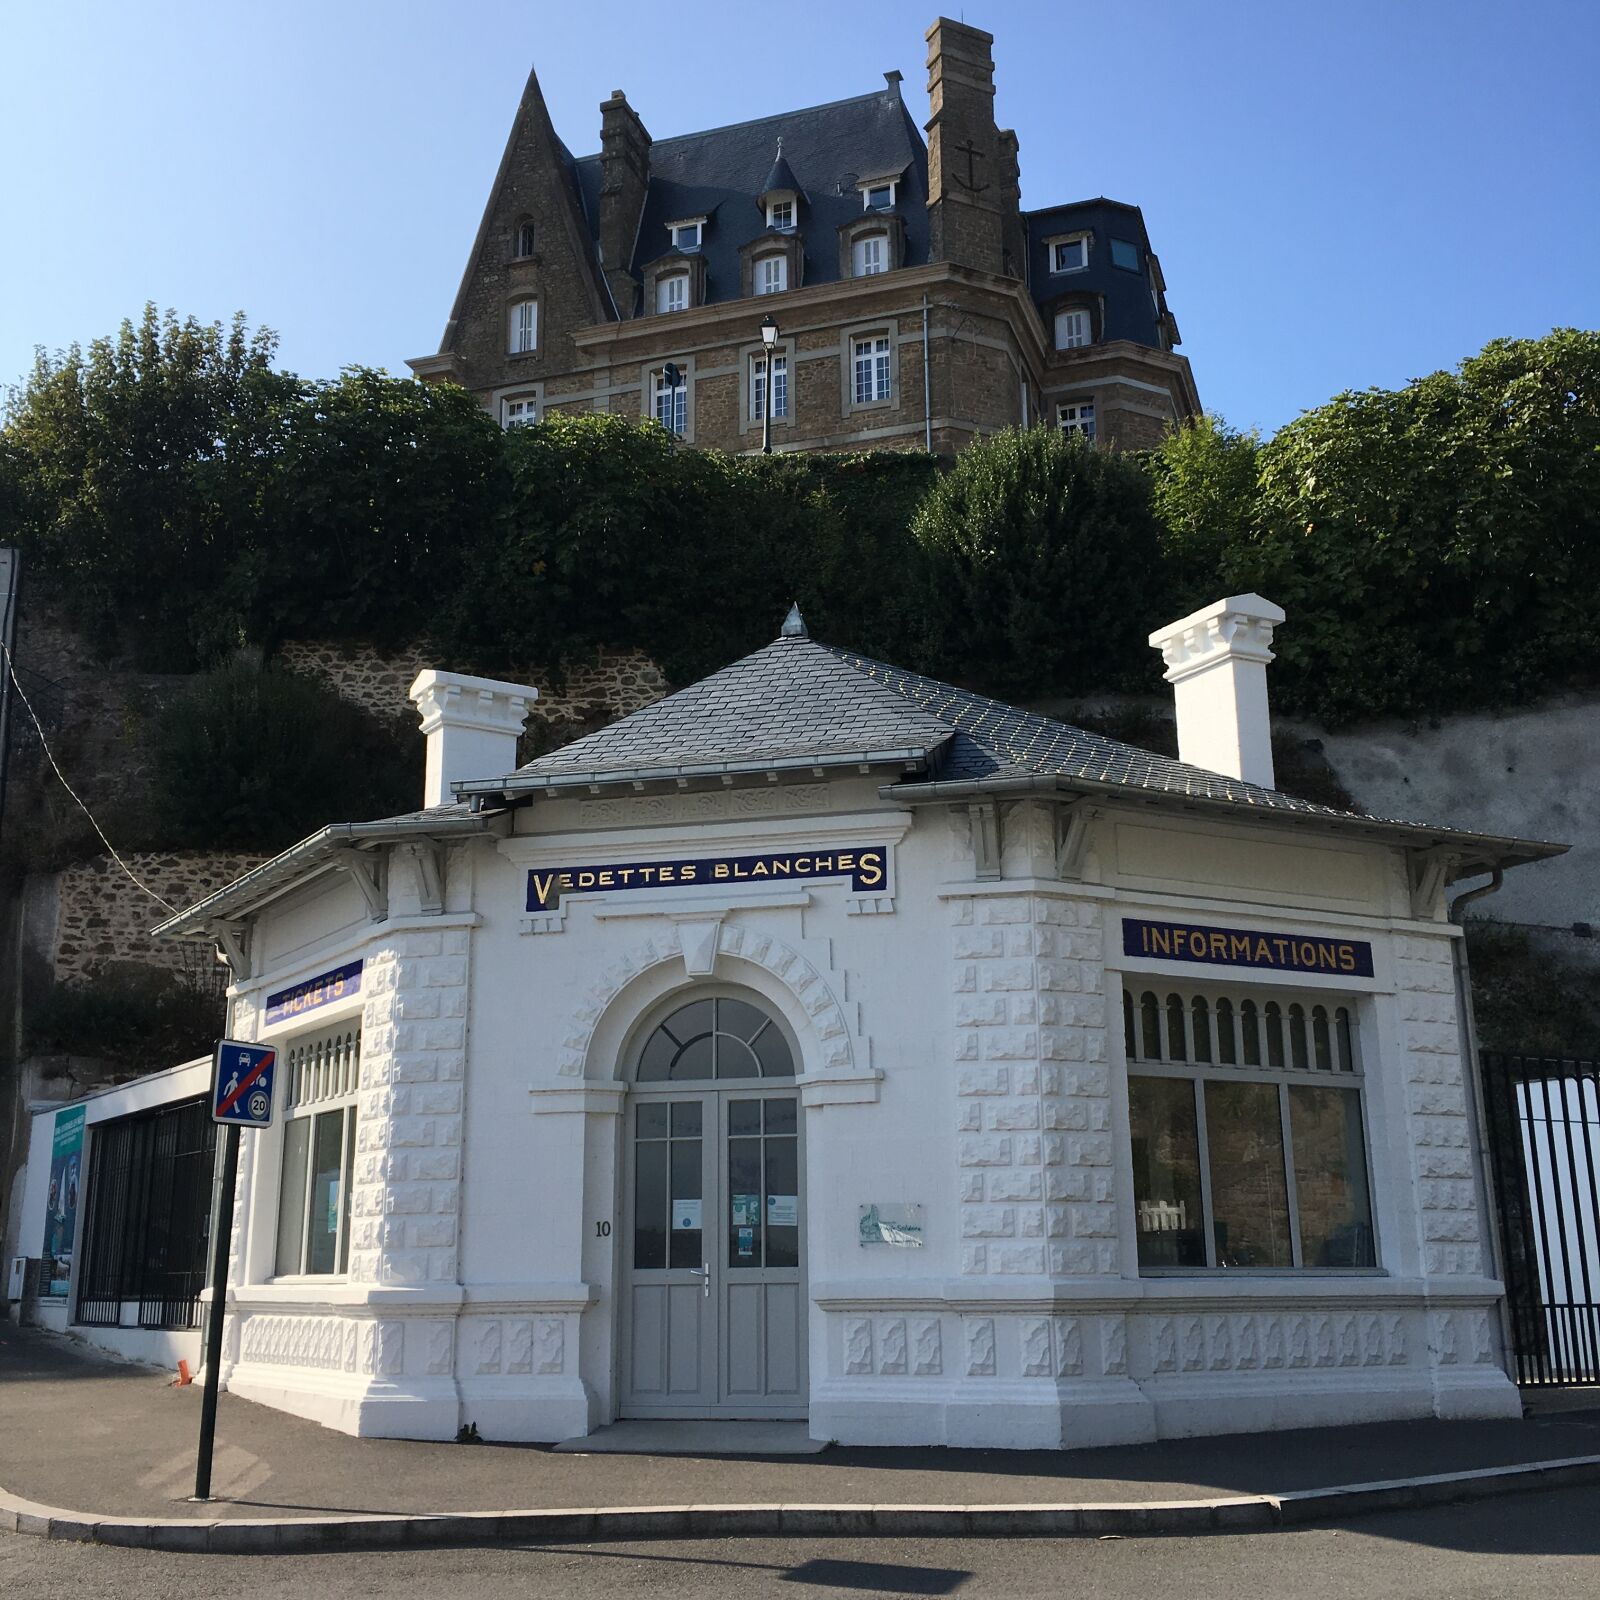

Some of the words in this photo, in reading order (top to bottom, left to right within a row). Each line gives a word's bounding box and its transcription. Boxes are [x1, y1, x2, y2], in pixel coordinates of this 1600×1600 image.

[533, 865, 697, 904] VEDETTES
[714, 853, 882, 885] BLANCHES
[1141, 926, 1356, 971] INFORMATIONS
[281, 972, 345, 1017] TICKETS
[252, 1101, 266, 1112] 20
[596, 1221, 611, 1237] 10
